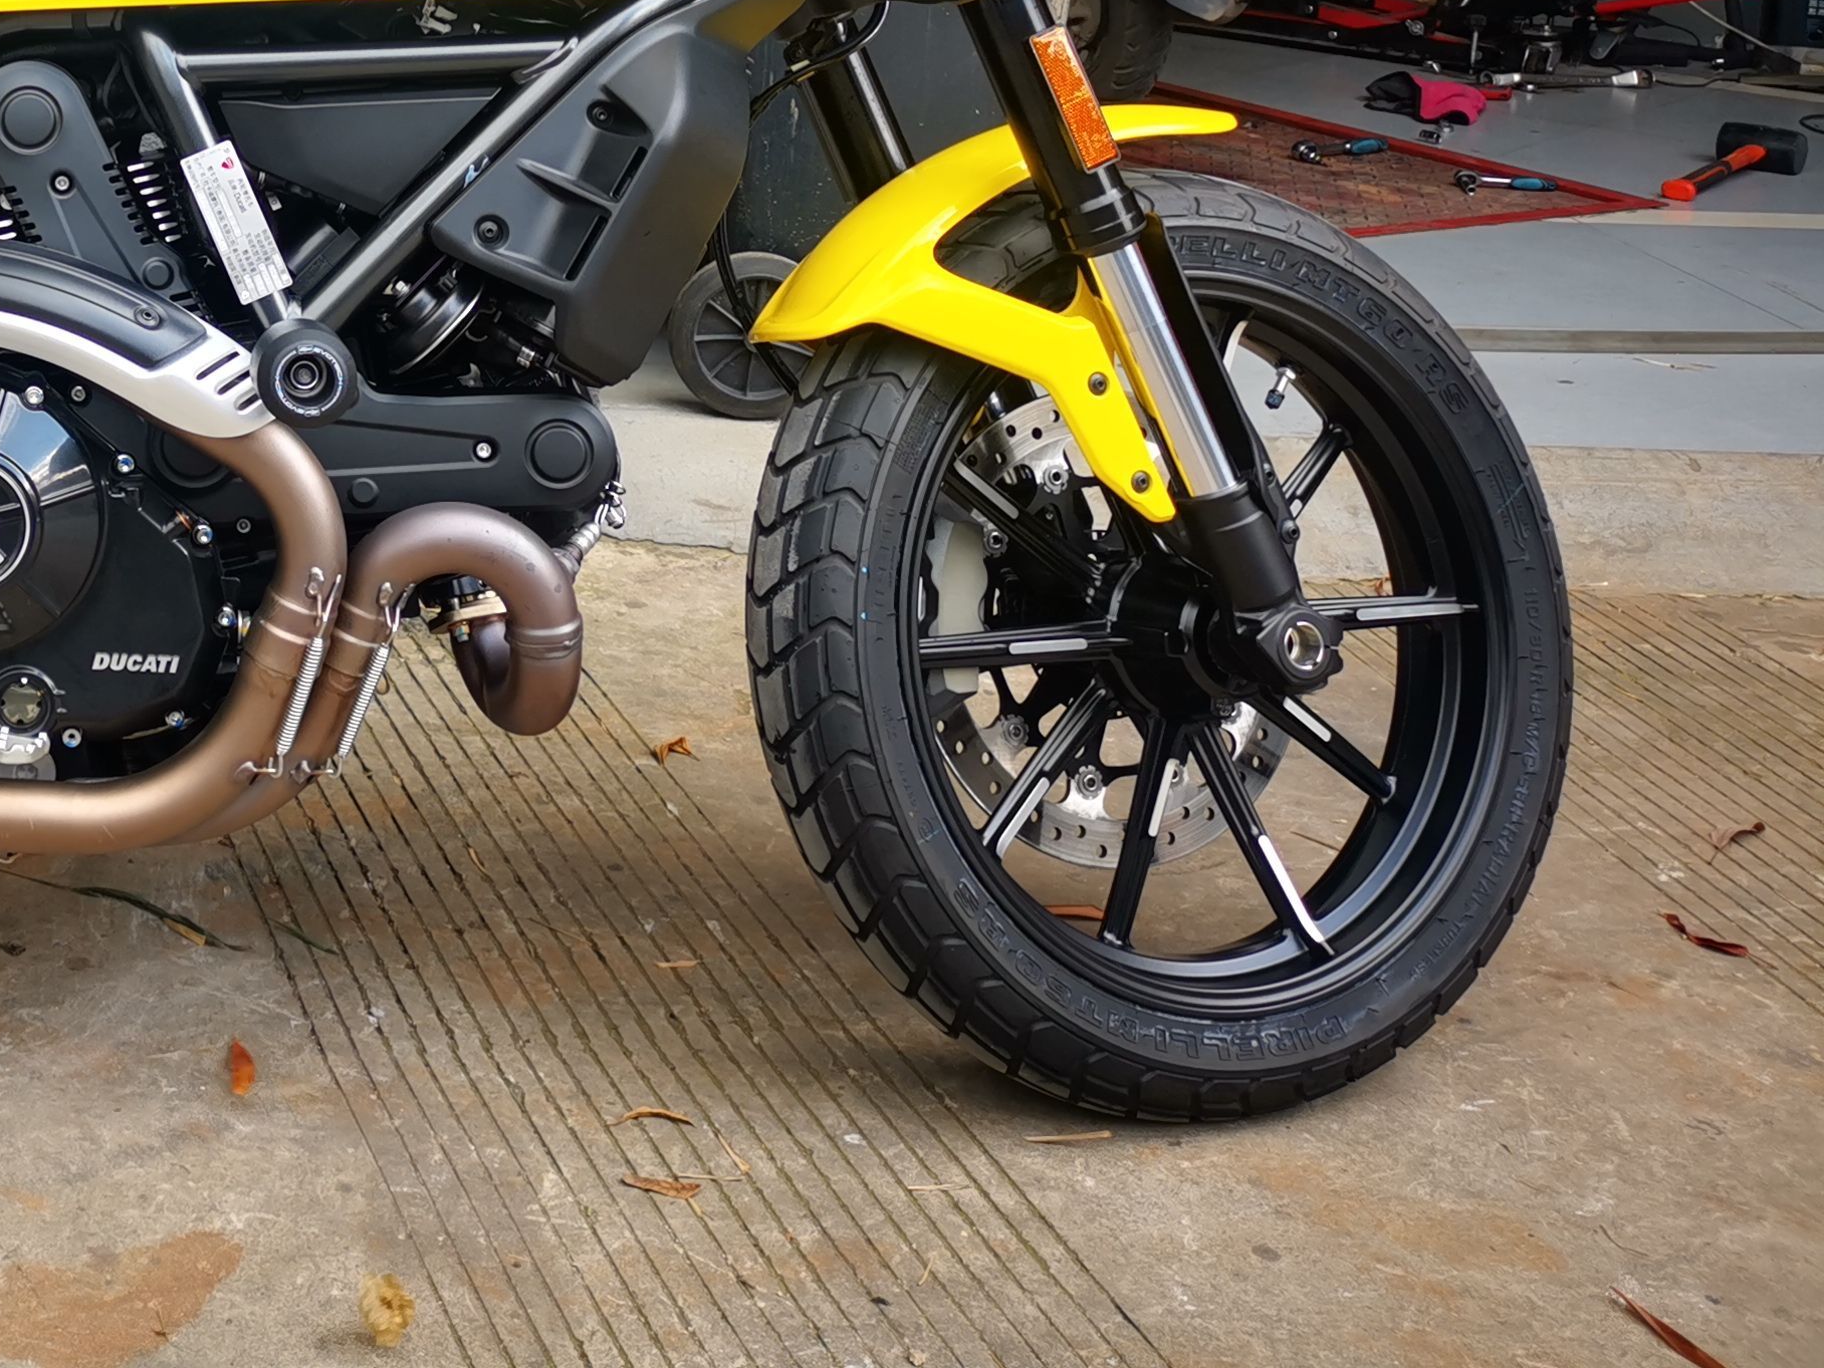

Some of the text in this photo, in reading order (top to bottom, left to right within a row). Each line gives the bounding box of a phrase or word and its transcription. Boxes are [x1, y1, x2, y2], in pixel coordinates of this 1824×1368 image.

[1417, 354, 1472, 414] RS
[91, 652, 180, 674] DUCATI
[953, 878, 1009, 951] RS
[1154, 1014, 1345, 1062] PIRELLI
